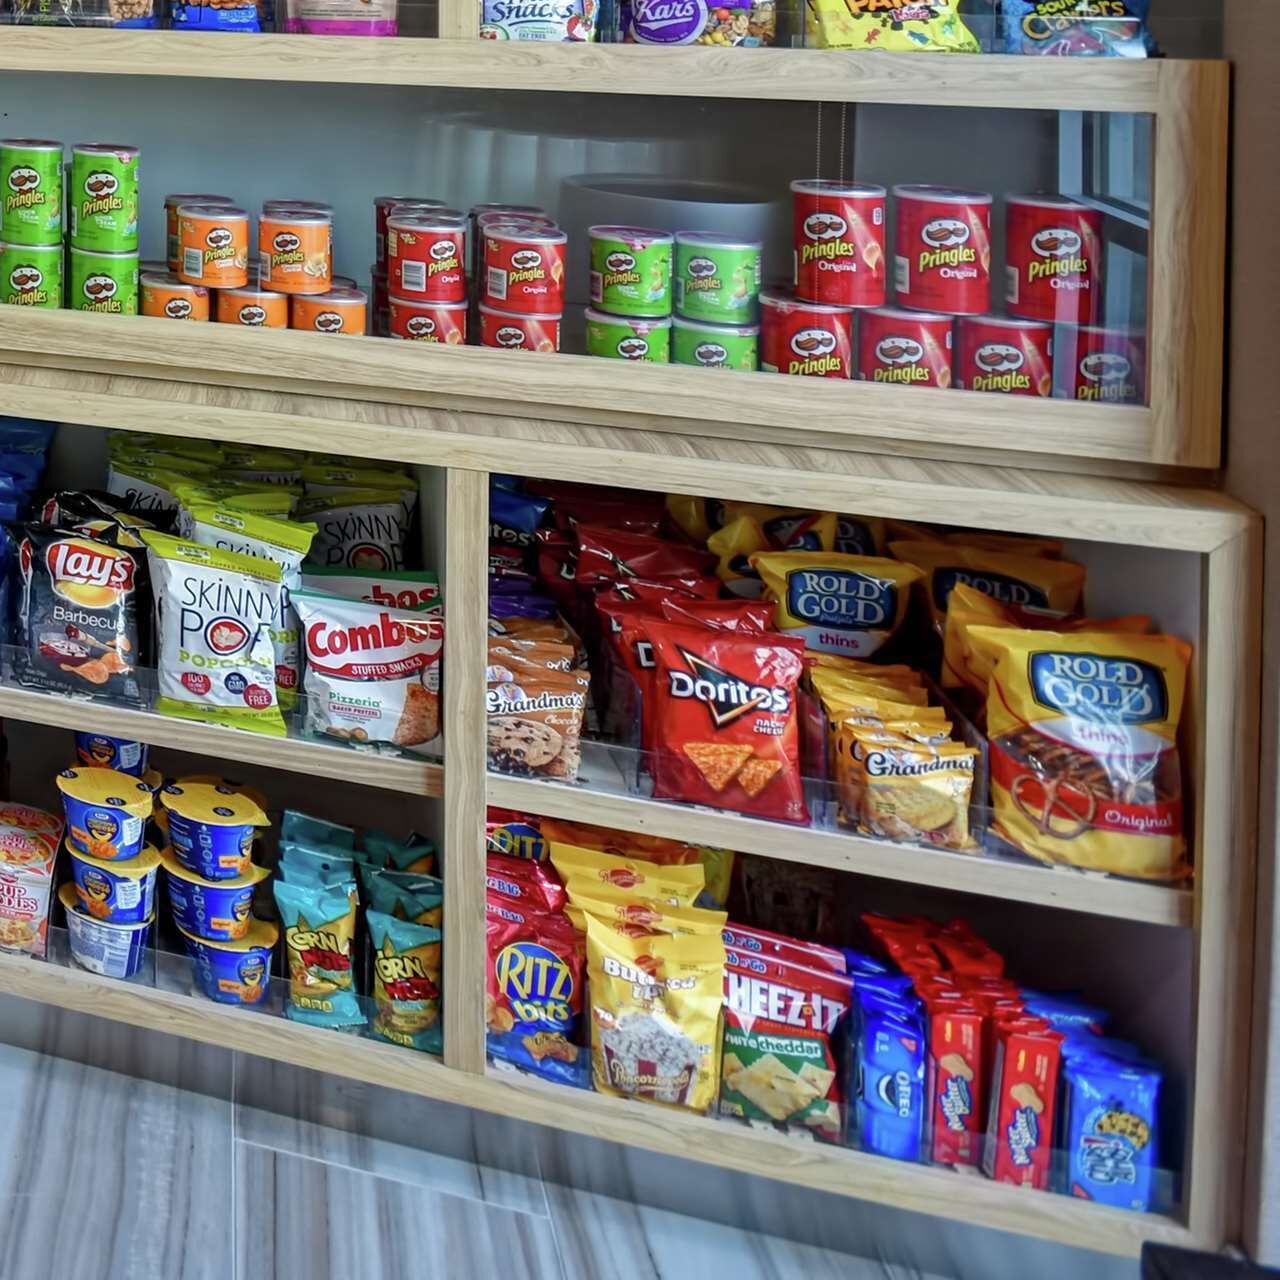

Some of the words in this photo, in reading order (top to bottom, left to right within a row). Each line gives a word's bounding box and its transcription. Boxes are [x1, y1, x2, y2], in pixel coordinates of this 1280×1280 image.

[491, 0, 575, 22] Snacks
[6, 189, 46, 211] Pringles
[82, 195, 122, 218] Pringles
[204, 246, 237, 264] Pringles
[271, 251, 305, 266] Pringles
[801, 240, 855, 262] Pringles
[918, 247, 976, 271] Pringles
[428, 257, 458, 276] Pringles
[508, 268, 546, 285] Pringles
[817, 260, 858, 273] Original
[939, 268, 978, 280] Original
[1027, 257, 1088, 282] Pringles
[604, 270, 641, 288] Pringles
[685, 278, 721, 293] Pringles
[1049, 278, 1090, 290] Original
[7, 288, 48, 306] Pringles
[788, 355, 841, 377] Pringles
[873, 366, 930, 385] Pringles
[972, 374, 1031, 393] Pringles
[1077, 383, 1137, 402] Pringles
[52, 544, 134, 589] Lay's
[802, 571, 880, 601] ROLD
[53, 605, 125, 632] Barbecue
[797, 594, 885, 625] GOLD
[307, 612, 443, 660] Combos
[818, 632, 860, 650] thins
[351, 662, 388, 676] STUFFED
[388, 657, 423, 675] SNACKS
[1050, 652, 1144, 686] ROLD
[227, 680, 245, 691] GMO
[668, 670, 789, 713] Doritos
[248, 693, 269, 705] FREE
[328, 690, 382, 708] Pizzeria
[488, 690, 585, 716] Grandma's
[1043, 677, 1153, 717] GOLD
[1103, 809, 1174, 830] Original
[496, 879, 522, 897] BAG
[286, 926, 340, 952] CORN
[745, 938, 761, 952] Go
[375, 950, 424, 979] CORN
[495, 944, 572, 1006] RITZ
[751, 959, 767, 974] Go
[512, 998, 571, 1023] bits
[758, 1031, 823, 1058] cheddar
[610, 1058, 691, 1091] Popcornopolis
[894, 1070, 912, 1119] OREO
